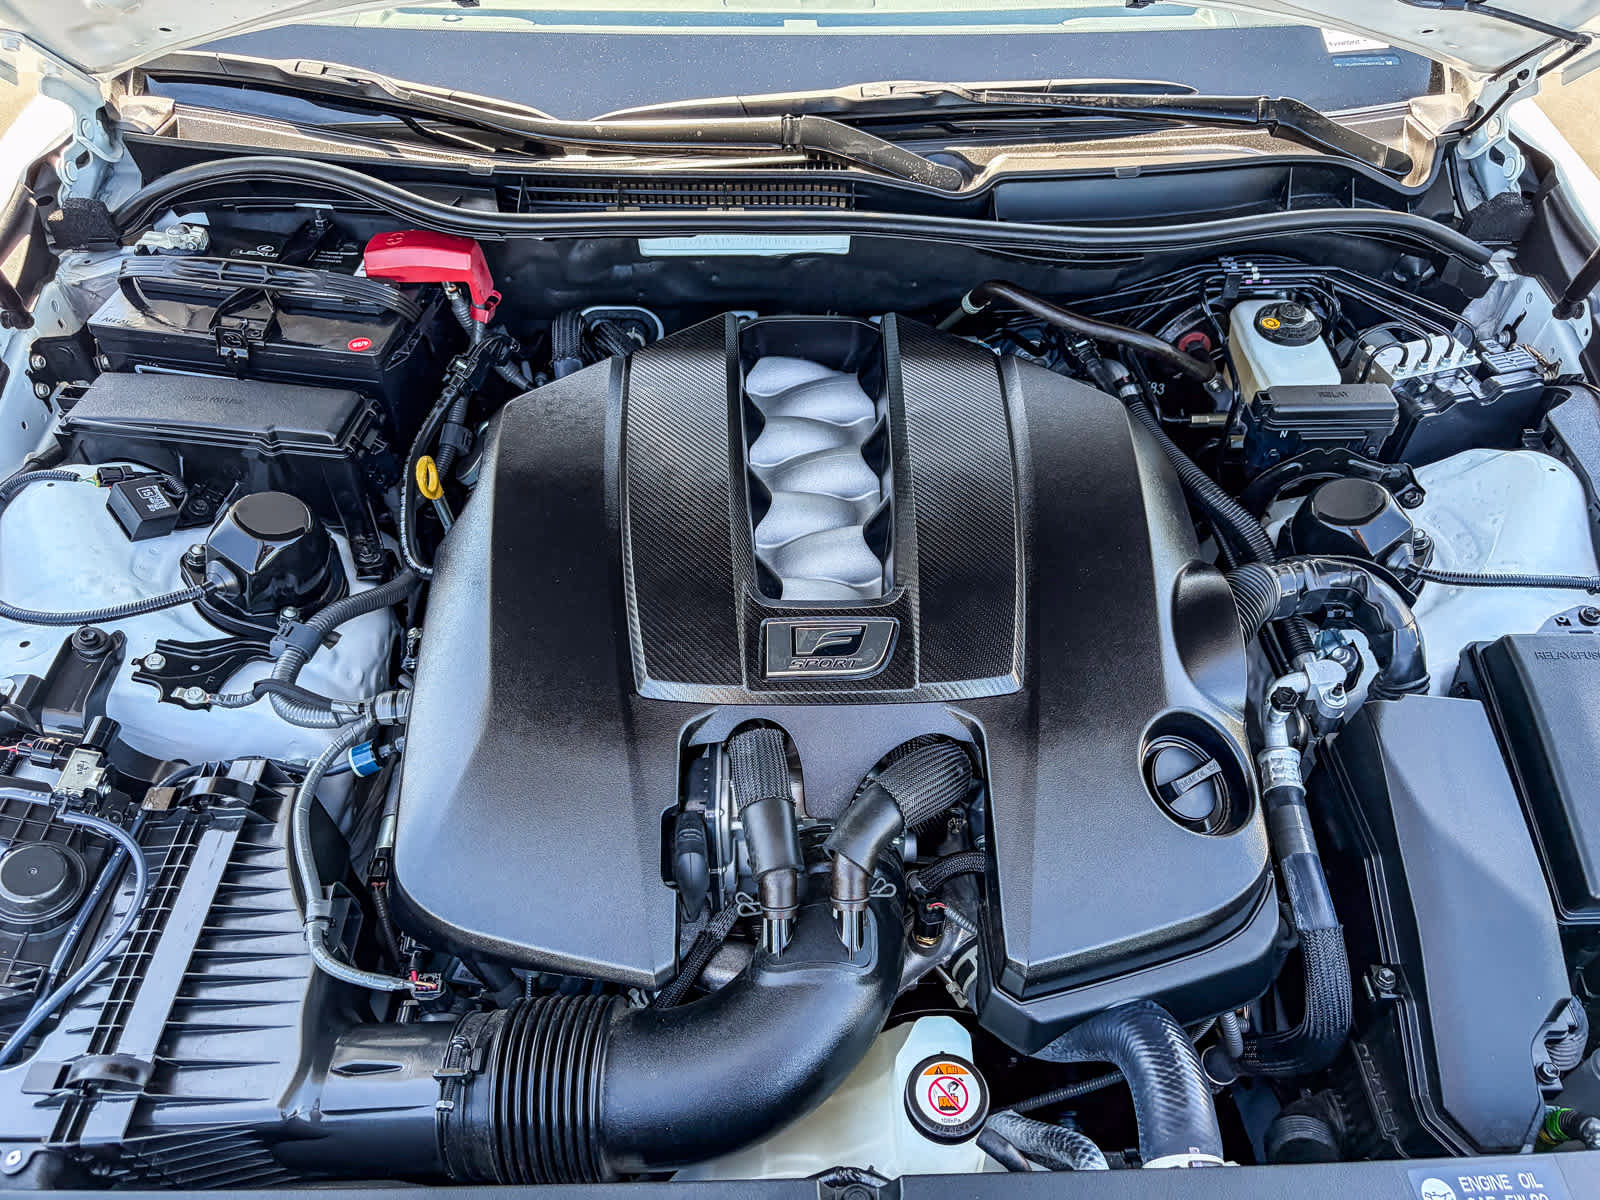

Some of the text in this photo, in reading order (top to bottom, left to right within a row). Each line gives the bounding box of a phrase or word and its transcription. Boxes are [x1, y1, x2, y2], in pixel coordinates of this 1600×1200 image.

[1534, 650, 1600, 660] RELAY&FUS
[789, 658, 862, 671] SPORT
[1457, 1172, 1544, 1193] ENGINE OIL
